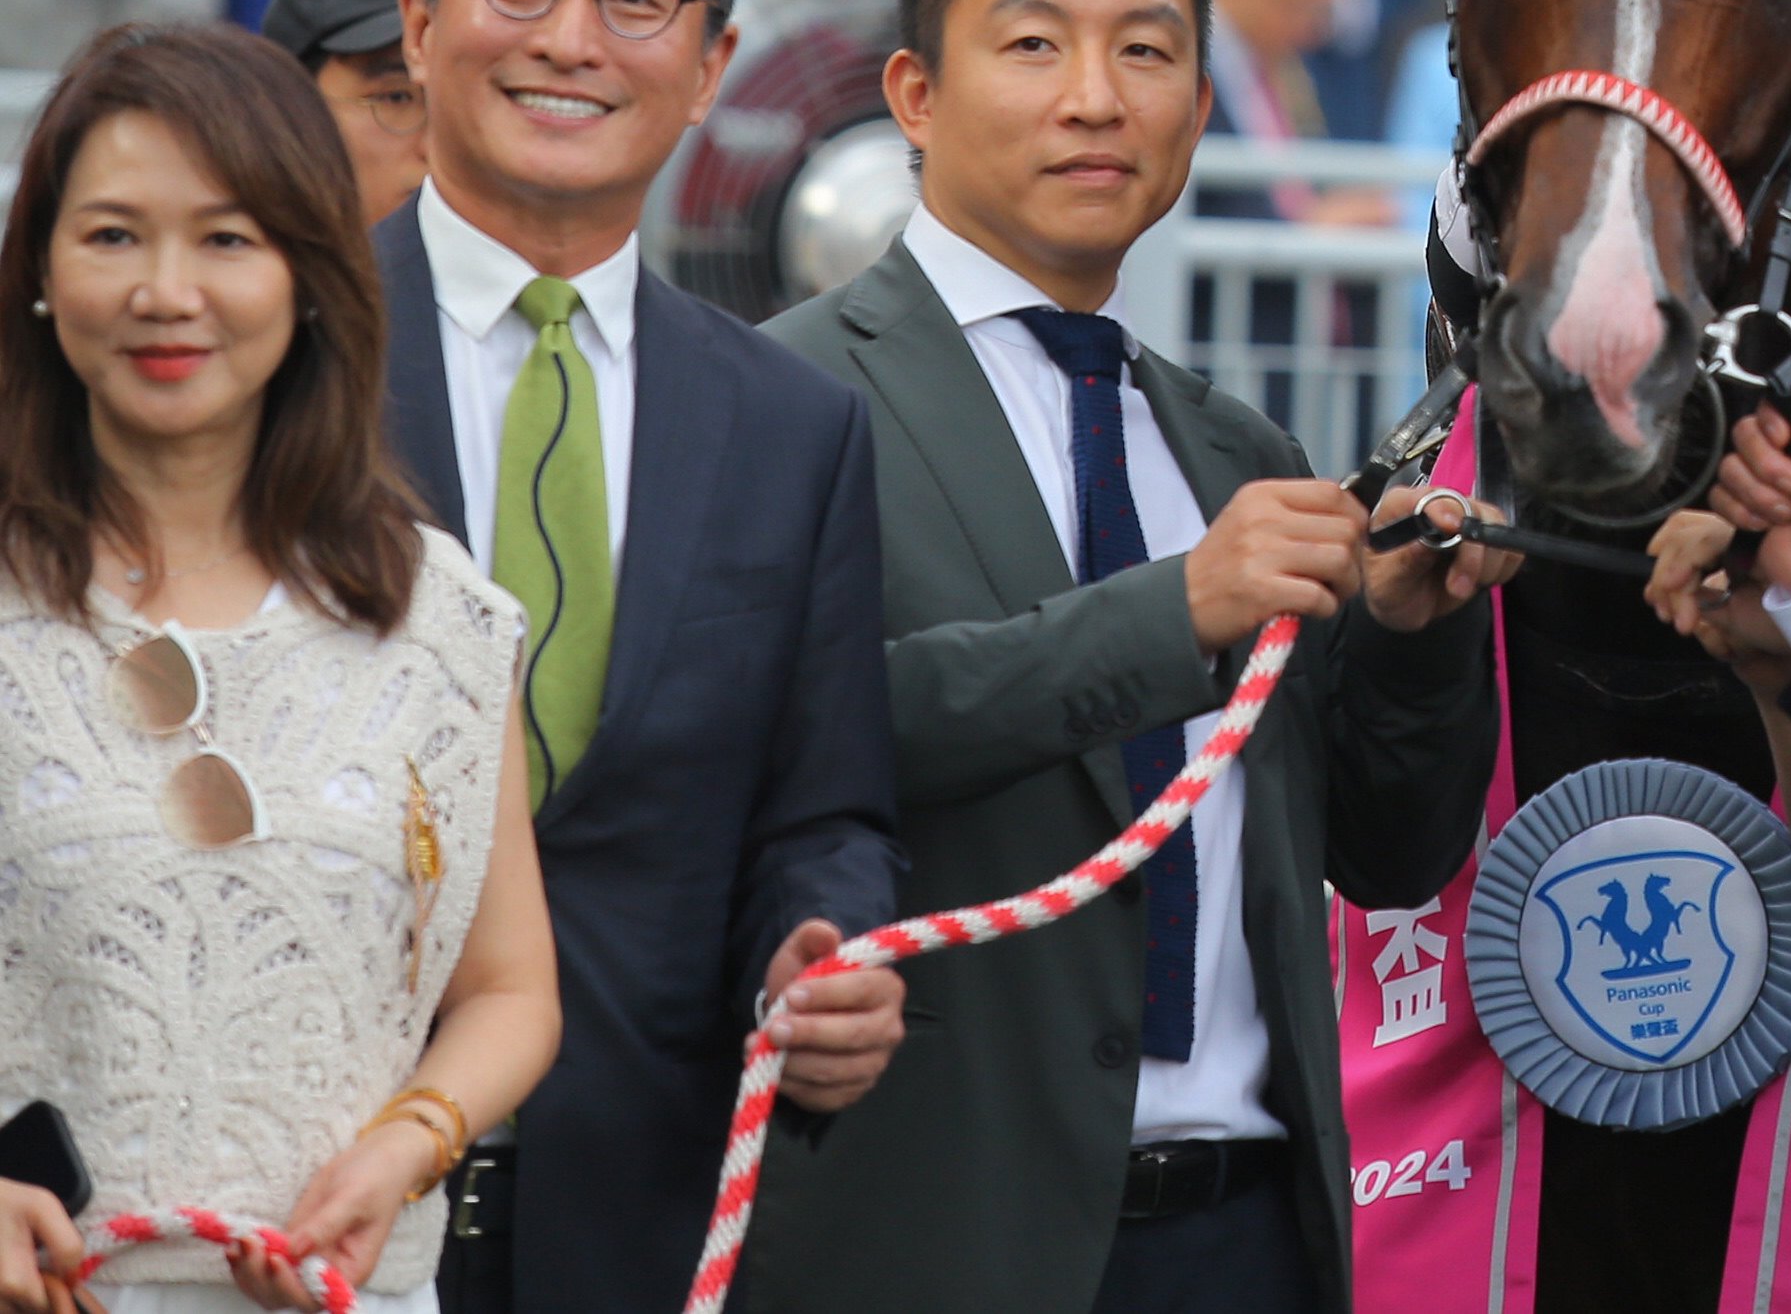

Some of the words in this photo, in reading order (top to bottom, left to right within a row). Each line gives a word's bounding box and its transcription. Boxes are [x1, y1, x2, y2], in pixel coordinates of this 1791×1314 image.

[1606, 977, 1692, 1003] Panasonic
[1639, 1003, 1665, 1017] Cup
[1350, 1140, 1472, 1207] 024
